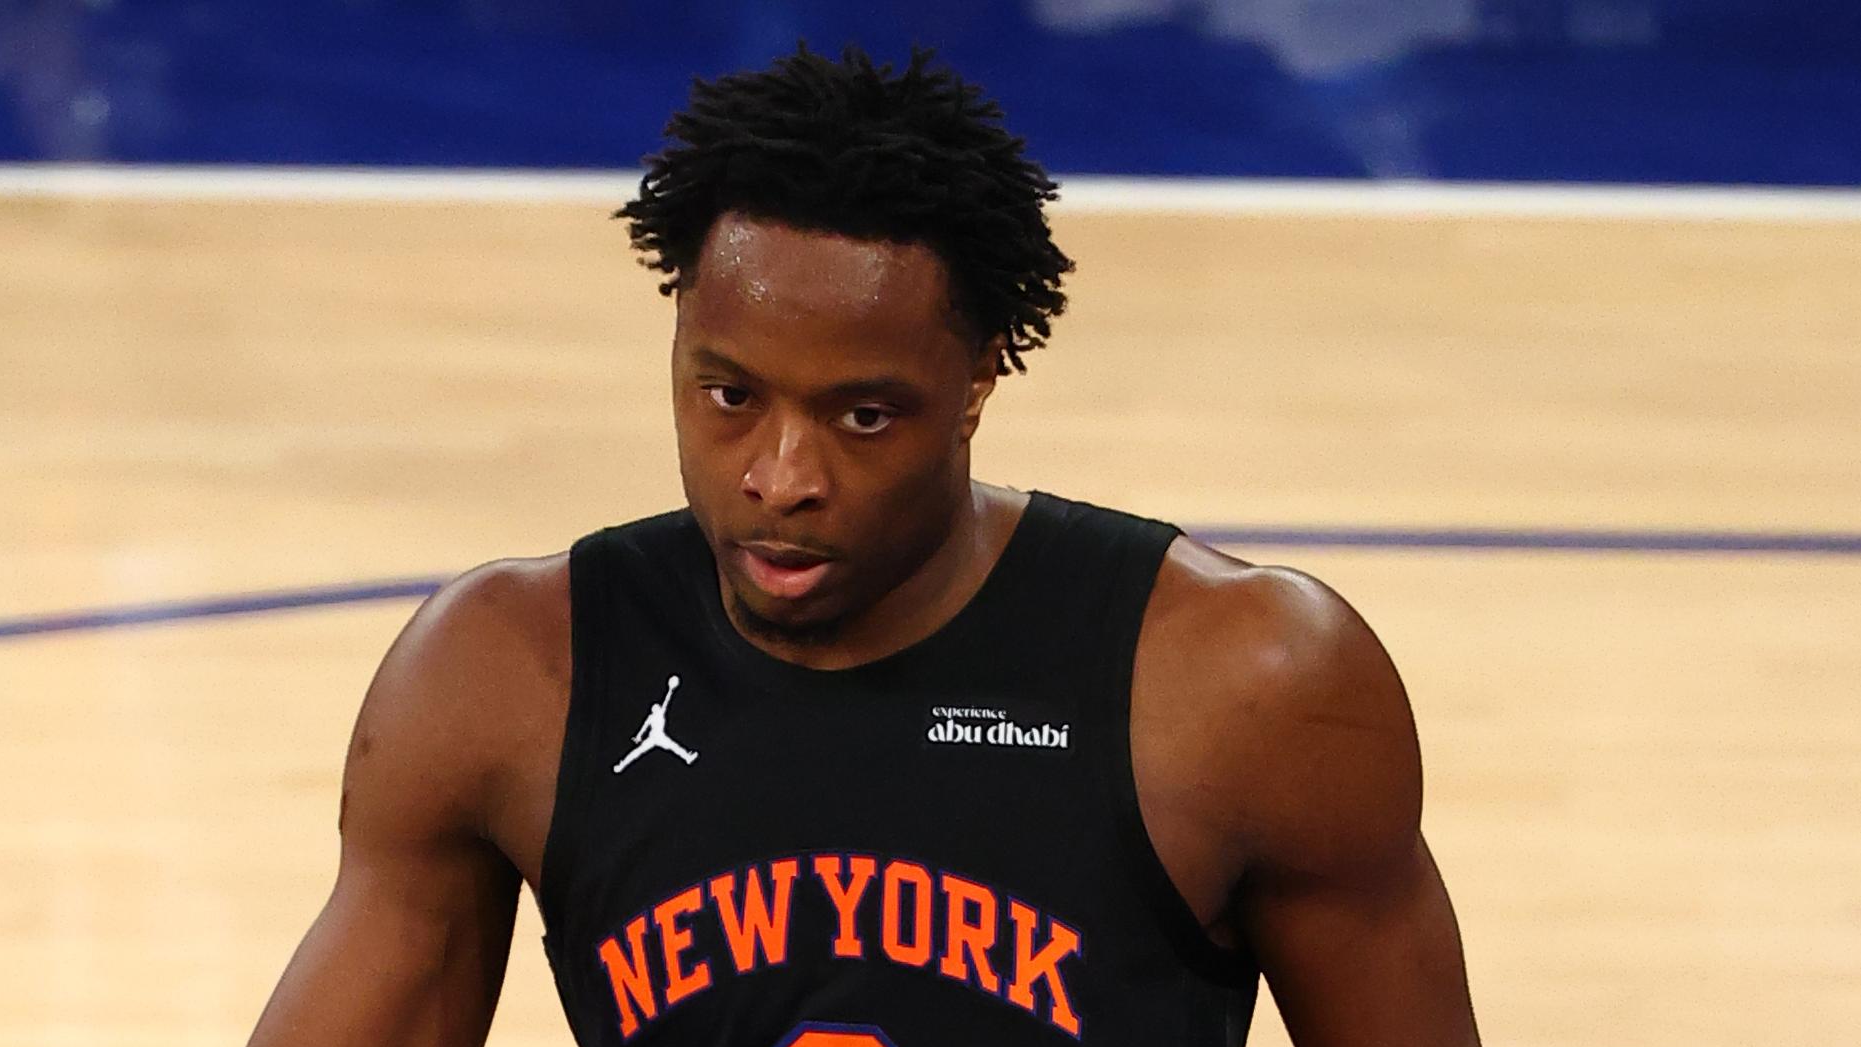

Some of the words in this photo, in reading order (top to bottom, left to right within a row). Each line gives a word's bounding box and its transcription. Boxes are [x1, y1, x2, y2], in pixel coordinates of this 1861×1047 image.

[931, 706, 1007, 720] experience
[927, 719, 982, 744] abu
[986, 721, 1070, 748] dhabi
[597, 854, 802, 1041] NEW
[811, 850, 1084, 1040] YORK
